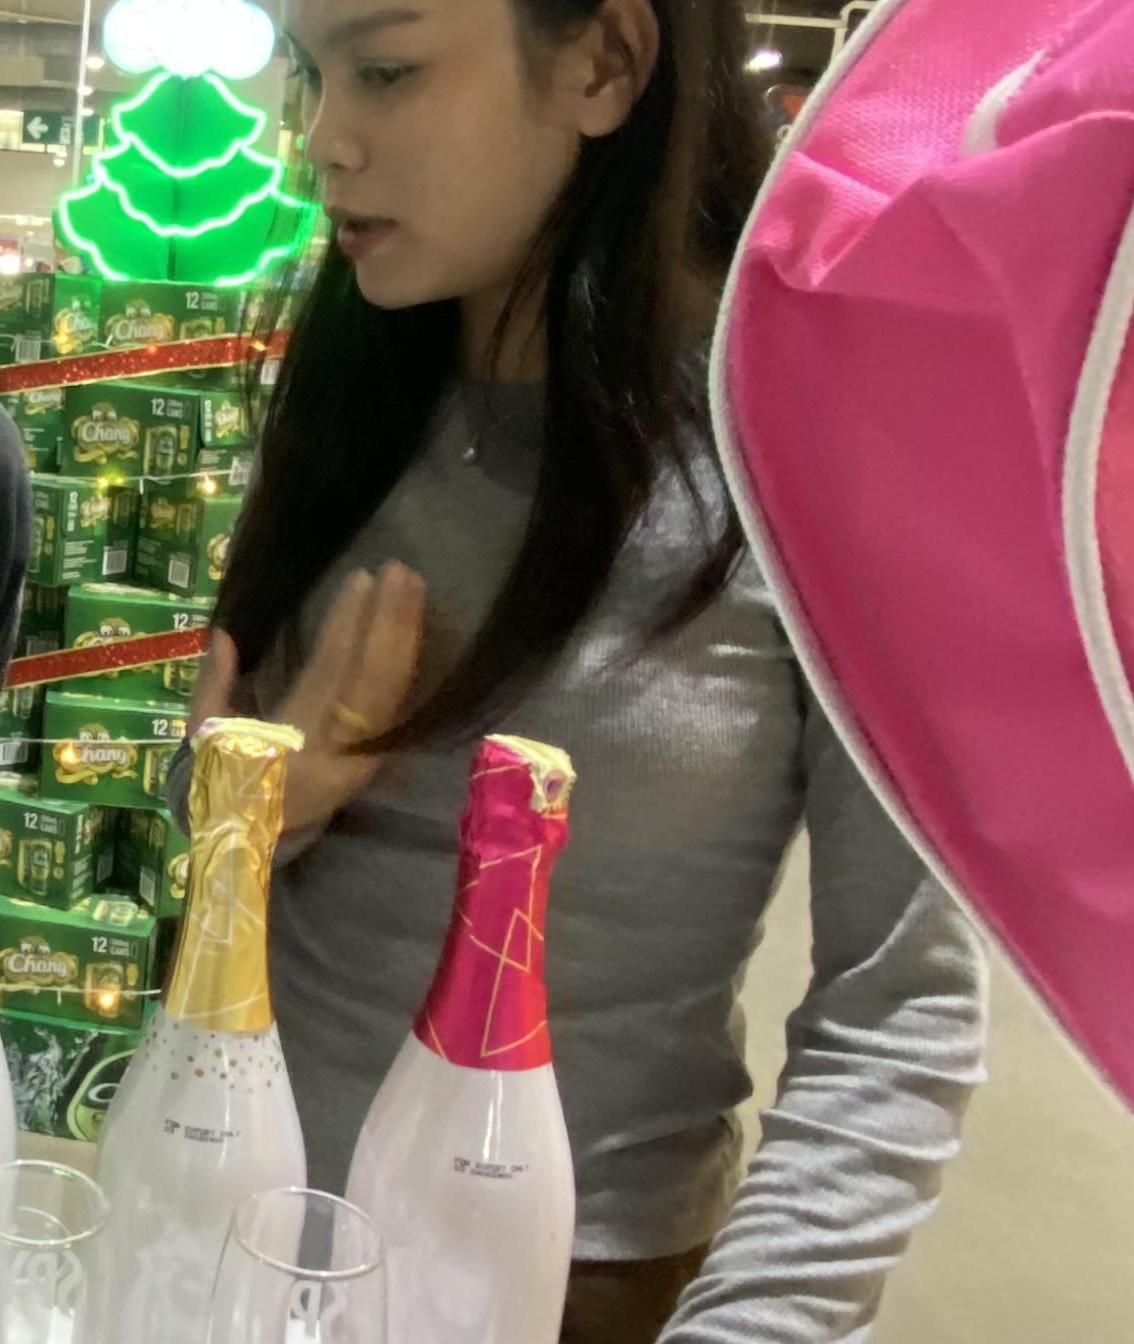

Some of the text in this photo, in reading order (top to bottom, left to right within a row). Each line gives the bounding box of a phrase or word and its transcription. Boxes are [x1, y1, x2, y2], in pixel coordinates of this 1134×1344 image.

[186, 291, 199, 309] 12
[114, 318, 166, 342] Chang
[151, 398, 165, 416] 12
[81, 421, 131, 445] Chang
[173, 613, 189, 629] 12
[152, 719, 169, 736] 12
[23, 812, 38, 829] 12
[92, 936, 108, 953] 12
[8, 955, 68, 978] Chang
